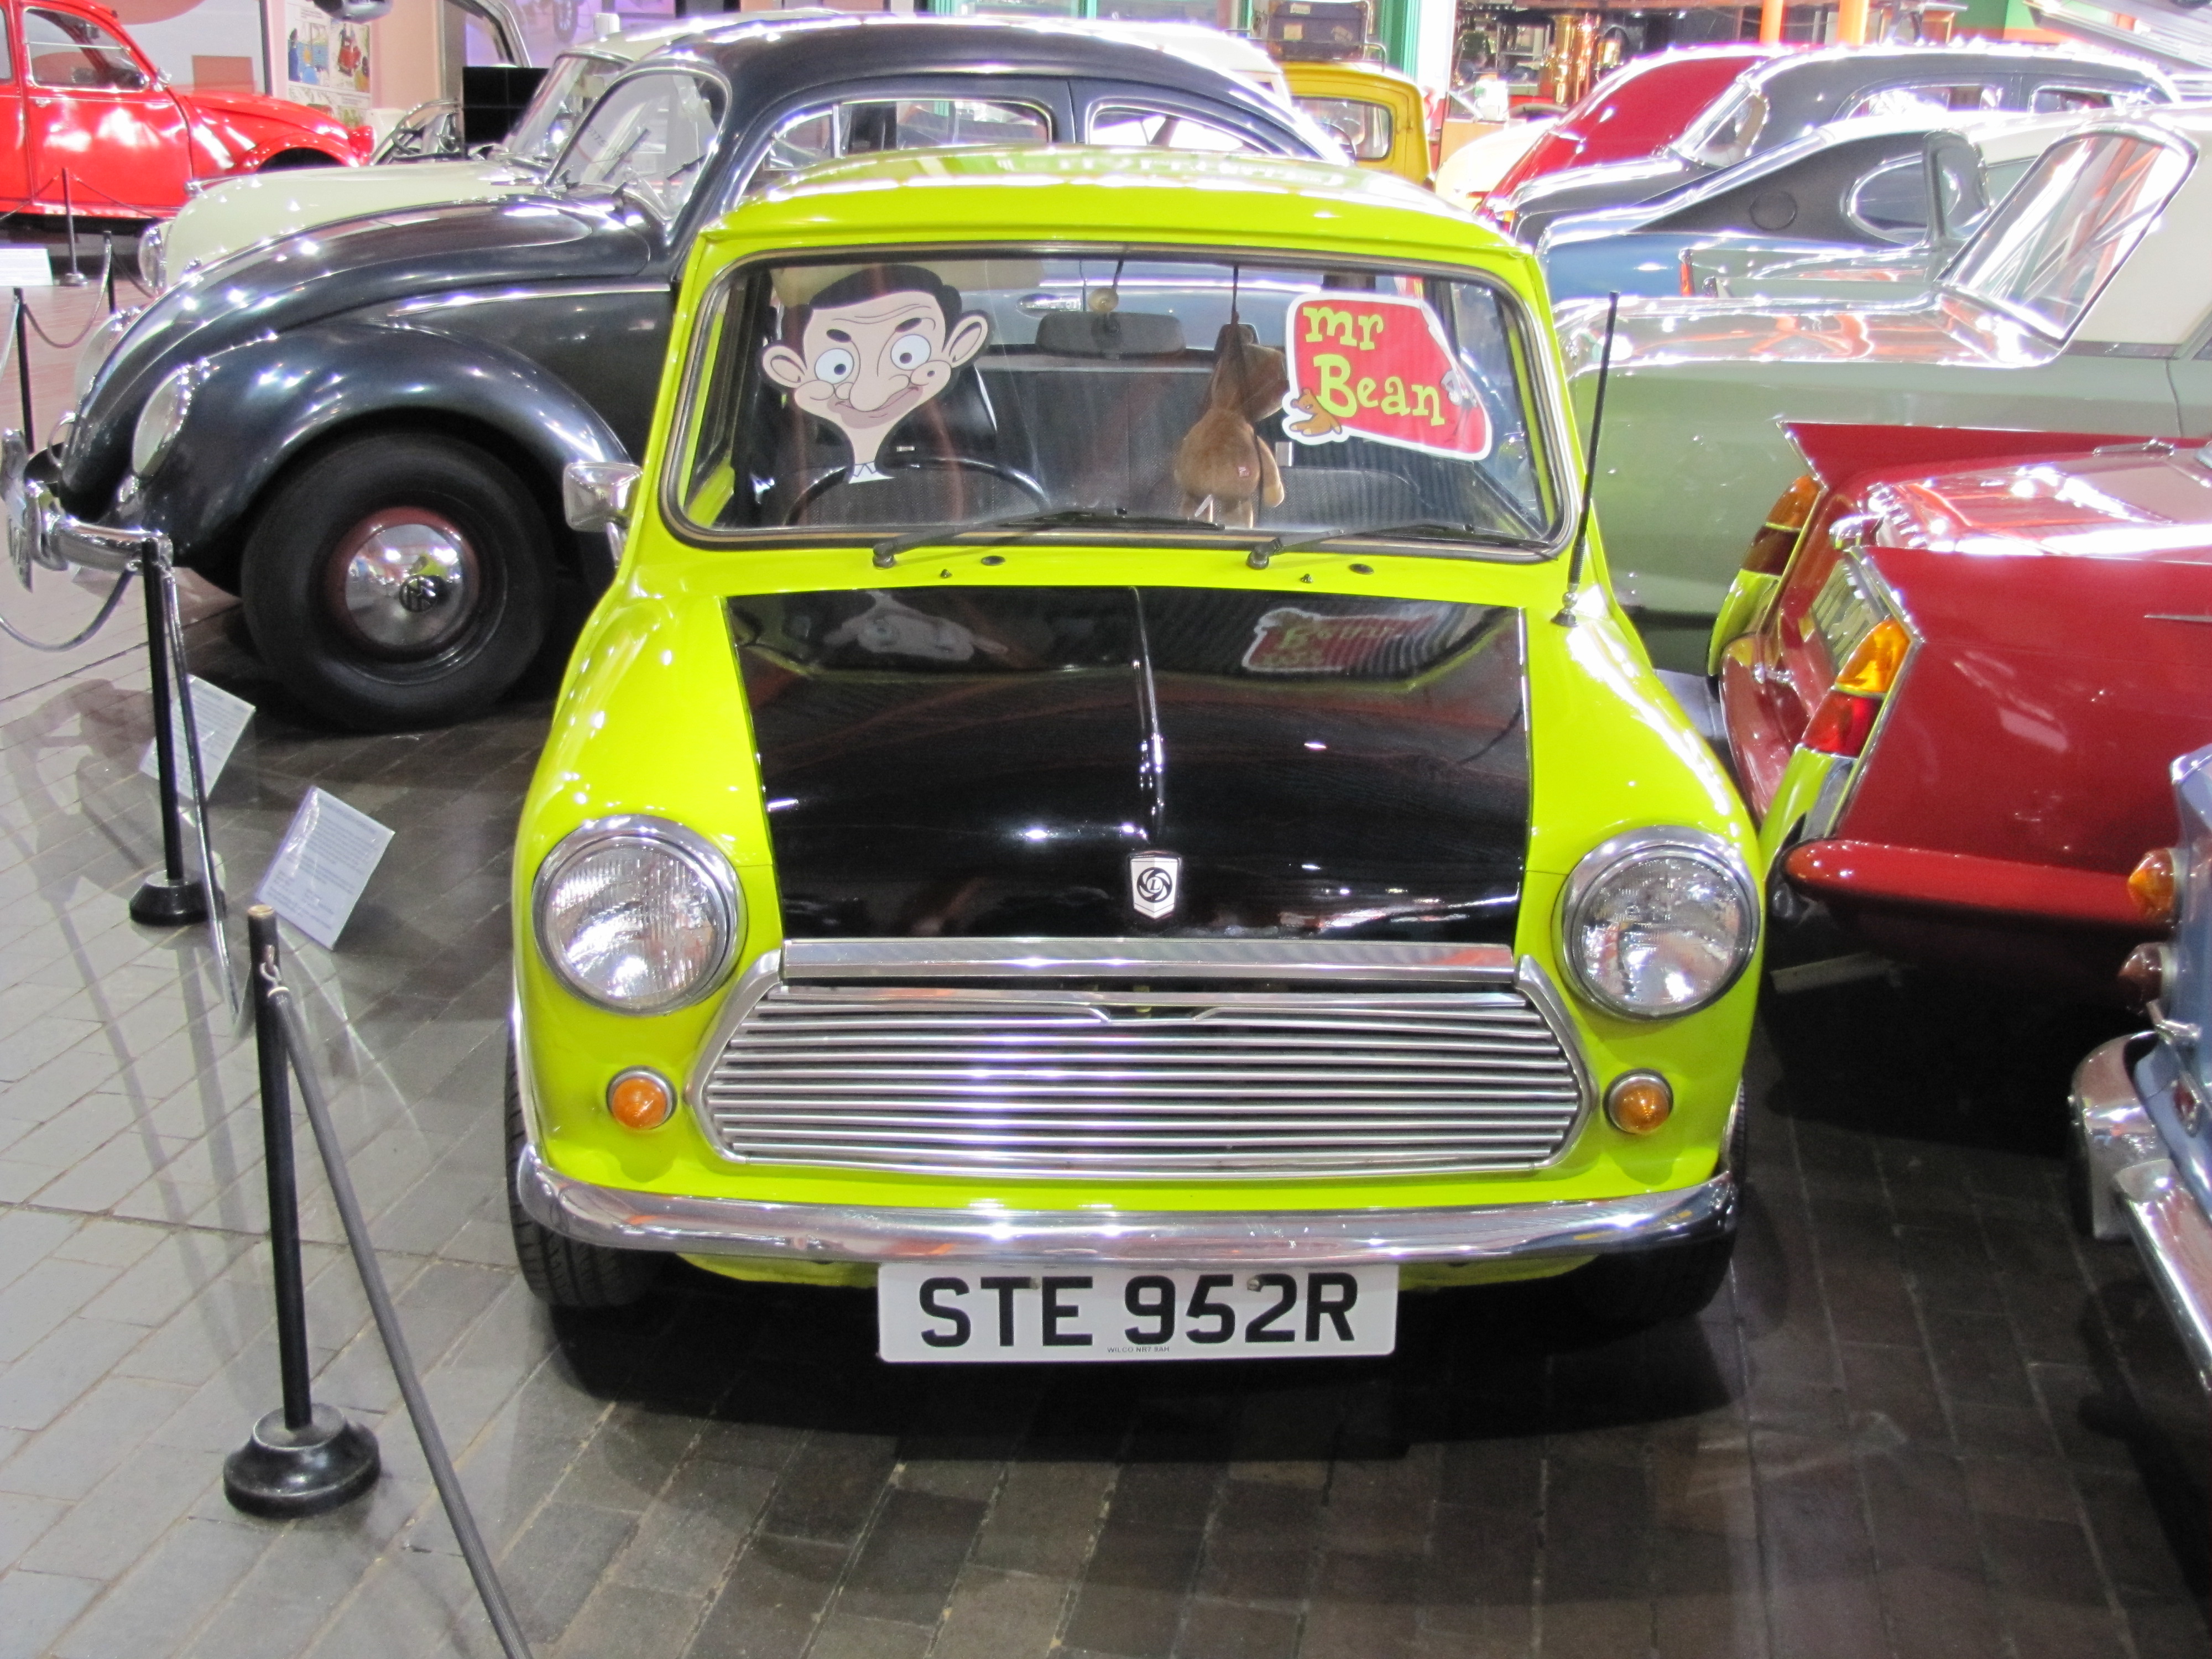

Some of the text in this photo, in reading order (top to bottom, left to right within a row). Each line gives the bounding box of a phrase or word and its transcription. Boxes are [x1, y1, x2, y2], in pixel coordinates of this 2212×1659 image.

[1303, 306, 1384, 351] mr
[1313, 354, 1445, 426] Bean
[1150, 879, 1161, 890] L
[919, 1272, 1358, 1347] STE 952R
